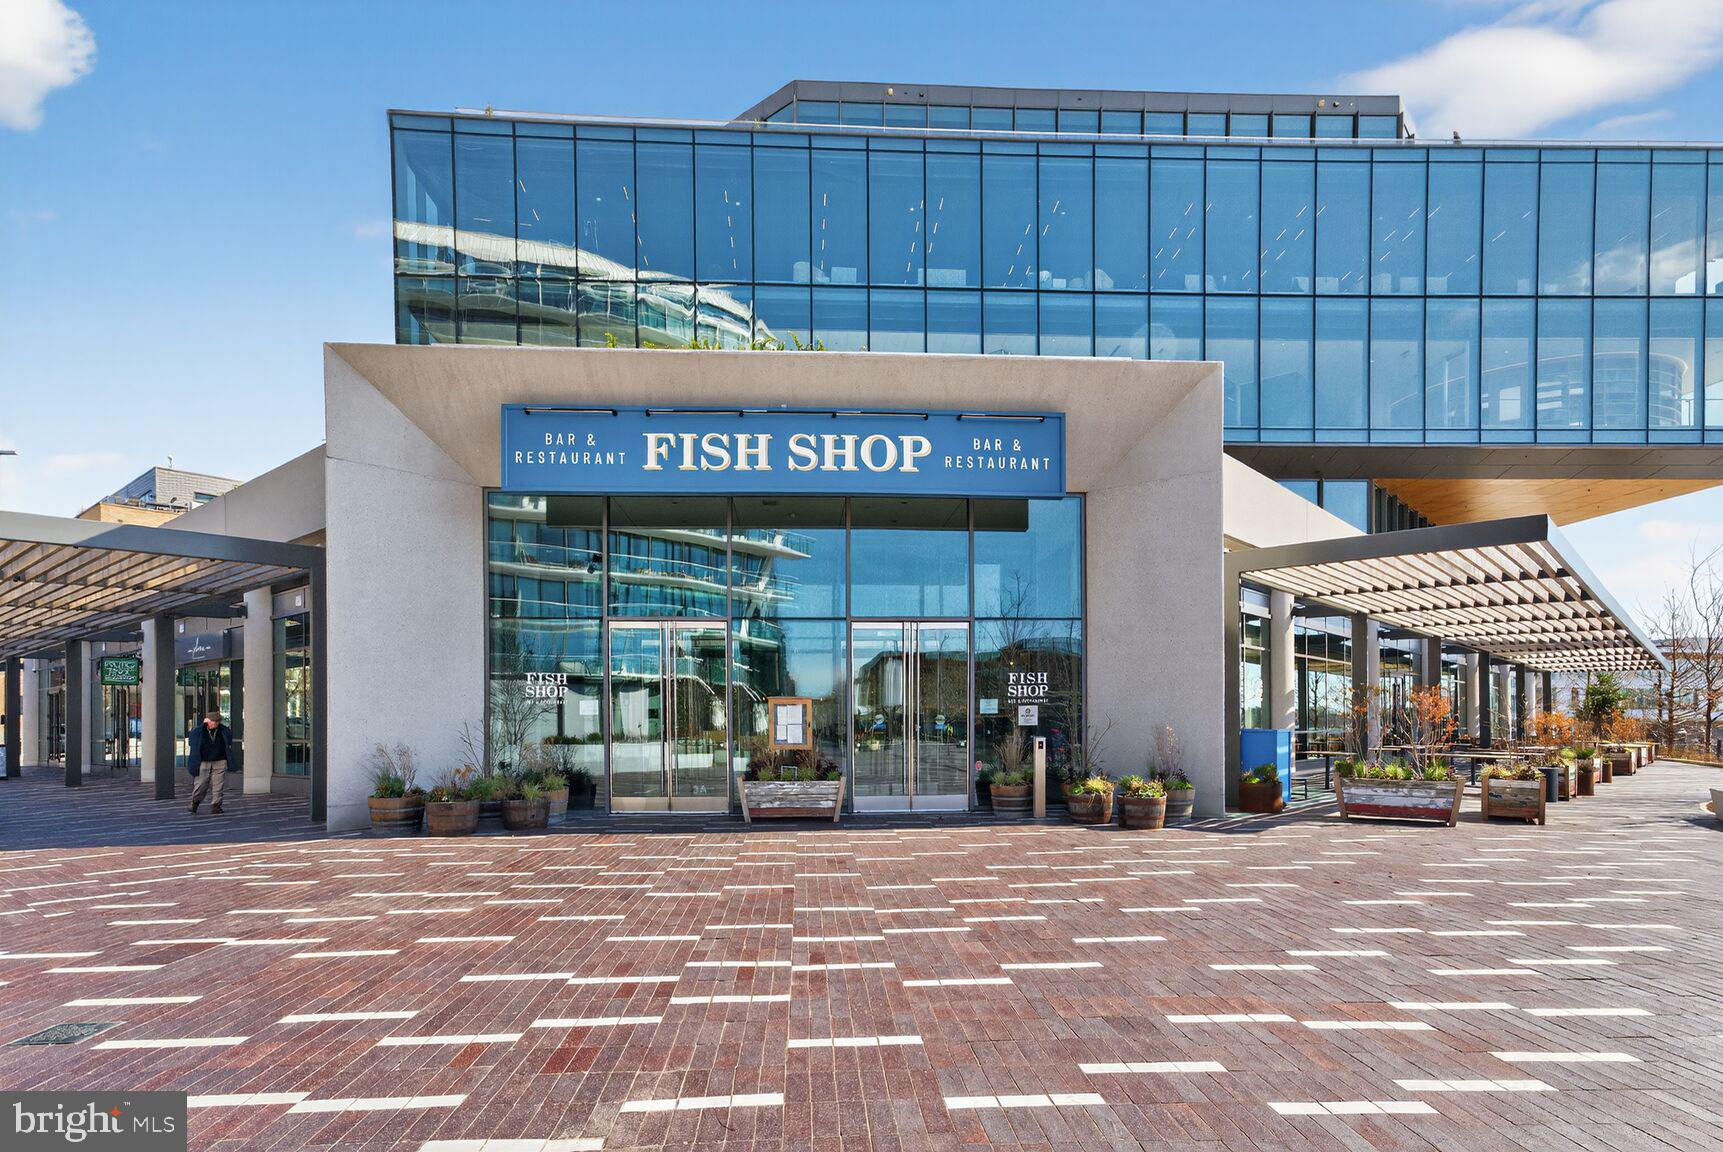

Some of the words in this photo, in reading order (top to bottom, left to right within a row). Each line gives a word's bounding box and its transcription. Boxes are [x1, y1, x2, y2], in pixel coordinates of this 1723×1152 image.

[545, 432, 576, 446] BAR
[587, 433, 596, 446] &
[973, 438, 1002, 451] BAR
[1013, 439, 1021, 451] &
[515, 451, 626, 465] RESTAURANT
[641, 432, 773, 471] FISH
[788, 433, 932, 472] SHOP
[945, 456, 1050, 470] RESTAURANT
[524, 672, 568, 685] FISH
[1008, 672, 1048, 684] FISH
[525, 685, 568, 698] SHOP
[1008, 685, 1049, 697] SHOP
